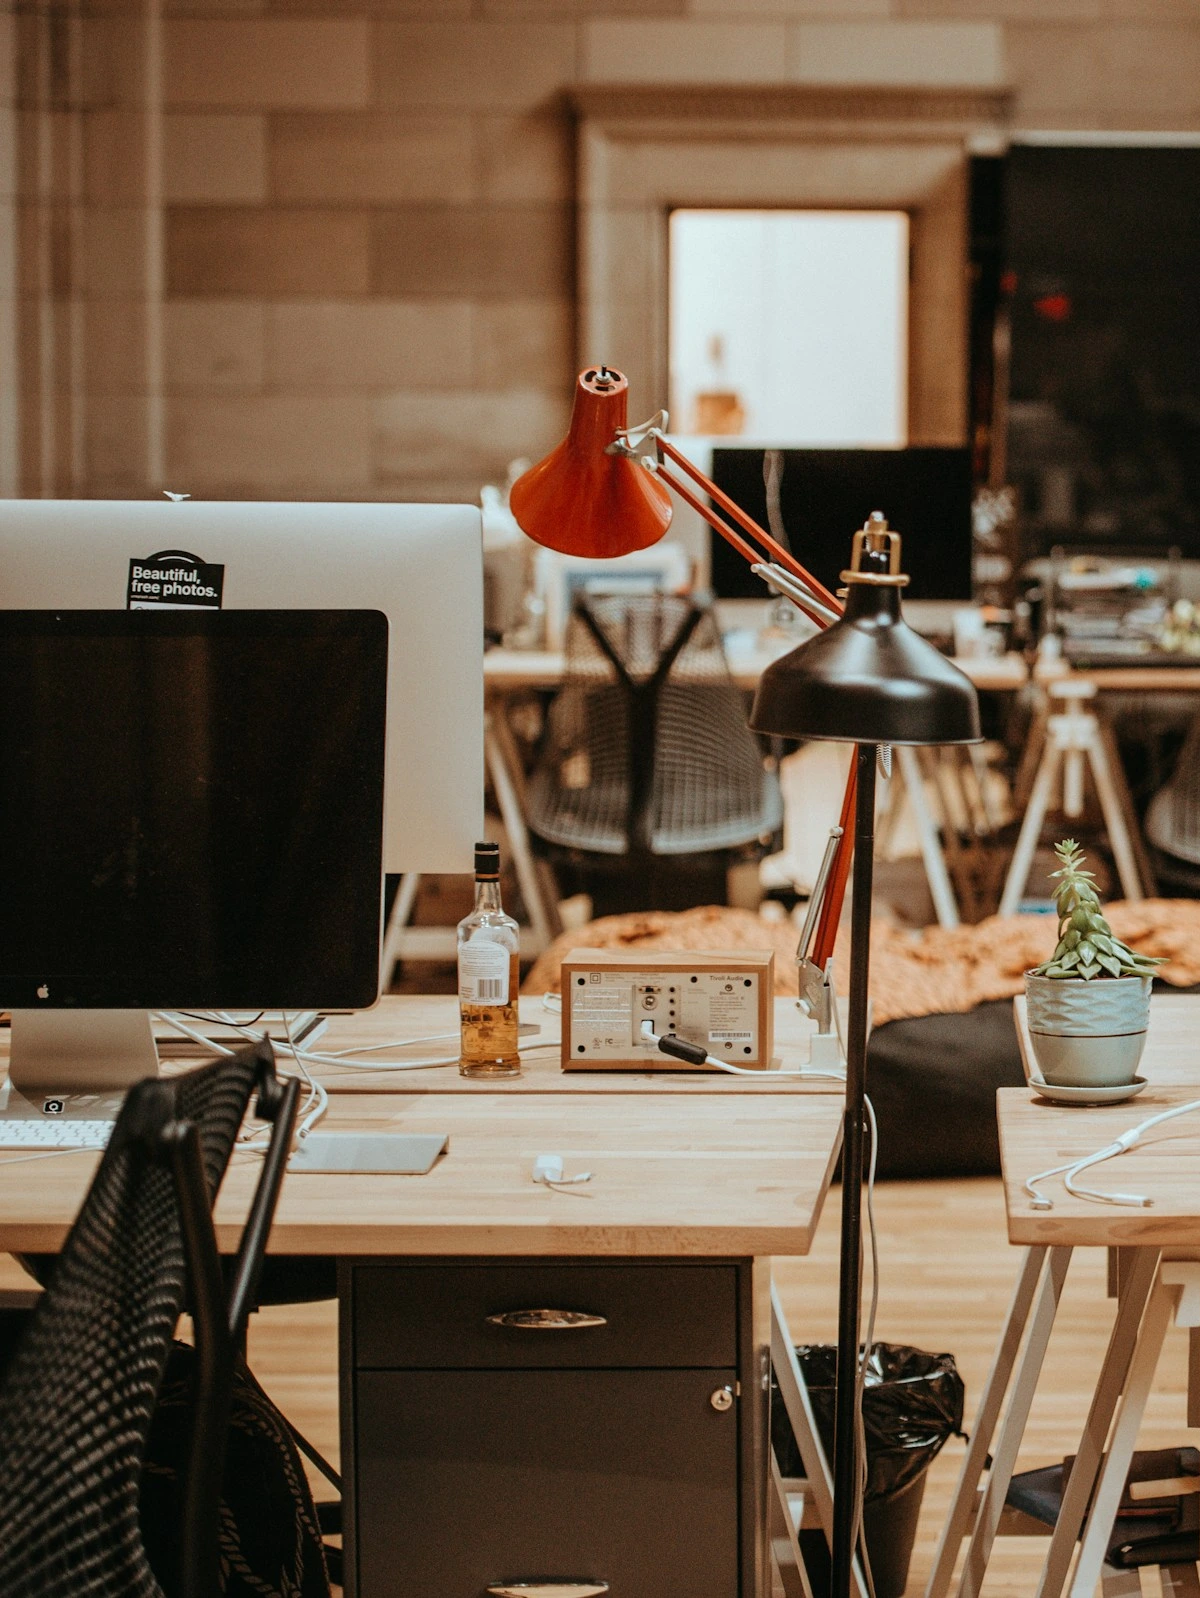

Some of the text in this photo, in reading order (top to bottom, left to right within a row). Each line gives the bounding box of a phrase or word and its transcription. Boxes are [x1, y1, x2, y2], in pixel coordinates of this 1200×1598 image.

[132, 566, 201, 584] Beautiful,
[131, 579, 218, 597] free photos.
